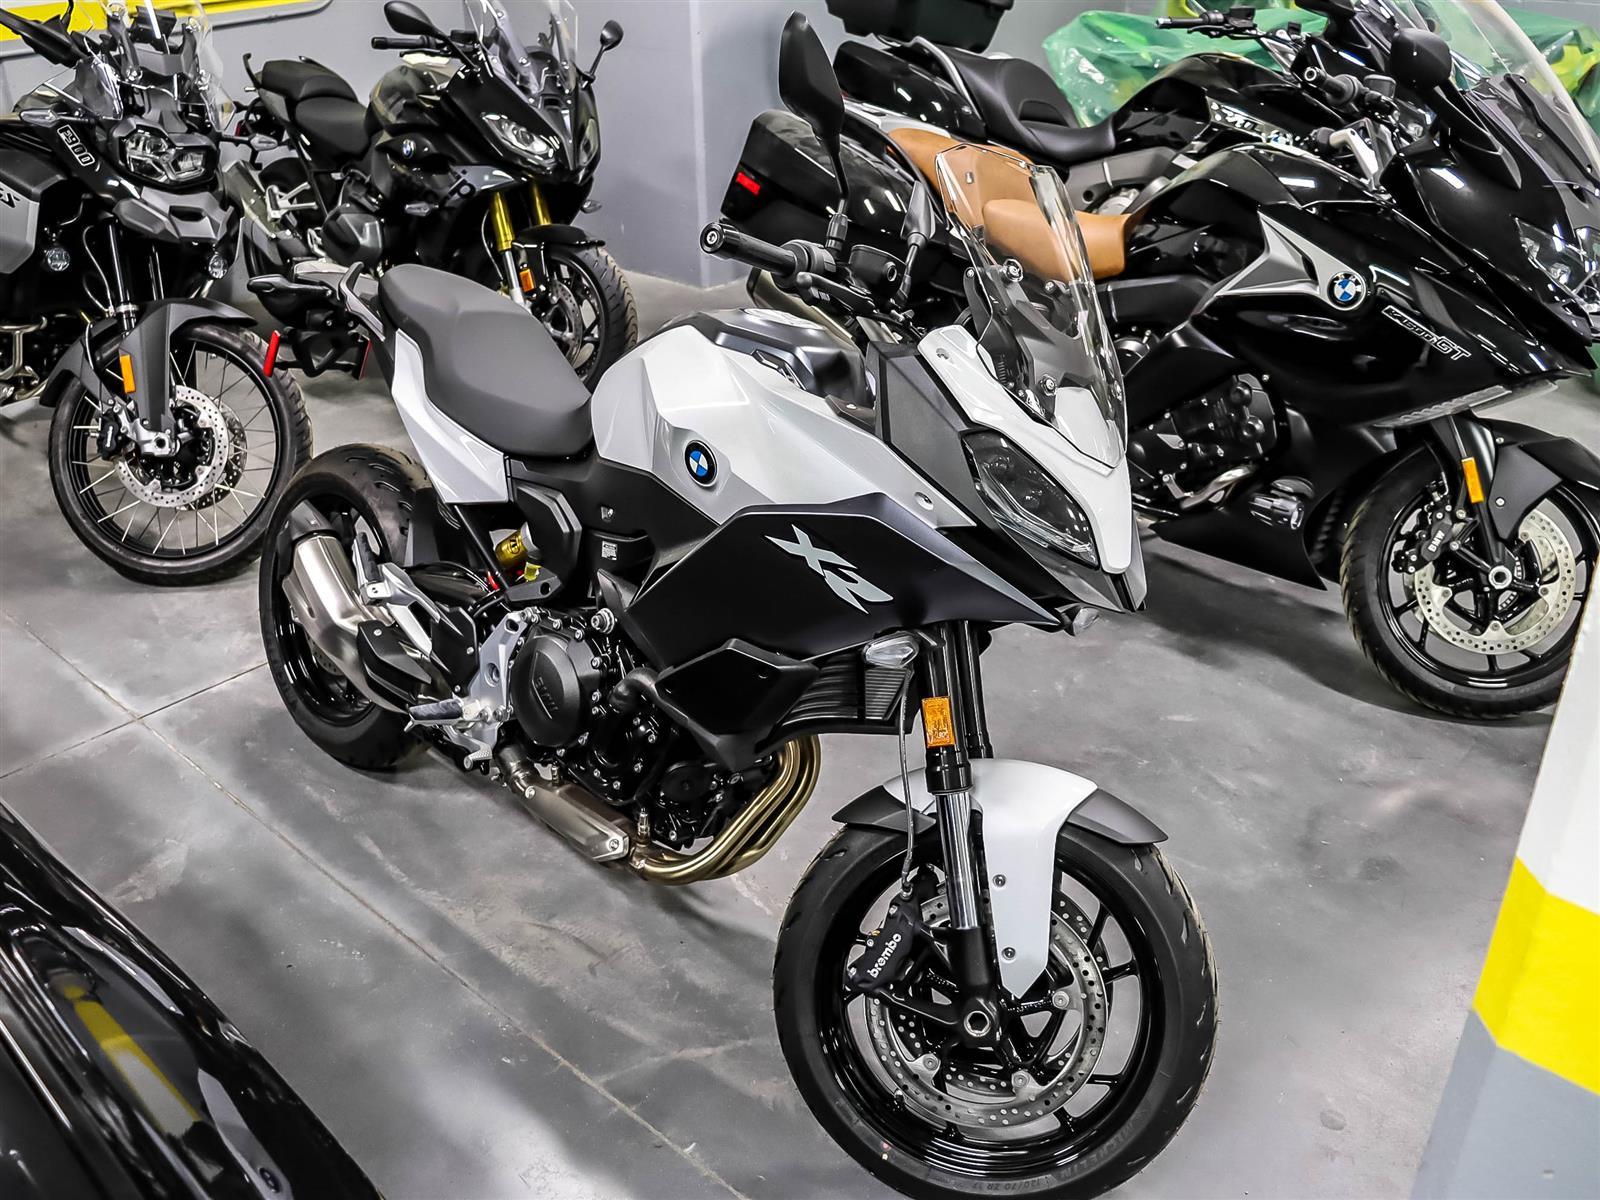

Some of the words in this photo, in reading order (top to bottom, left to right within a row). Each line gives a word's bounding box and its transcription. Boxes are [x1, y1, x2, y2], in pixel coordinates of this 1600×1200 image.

[1427, 530, 1445, 552] BMW
[764, 523, 894, 615] XR
[866, 933, 902, 978] brembo
